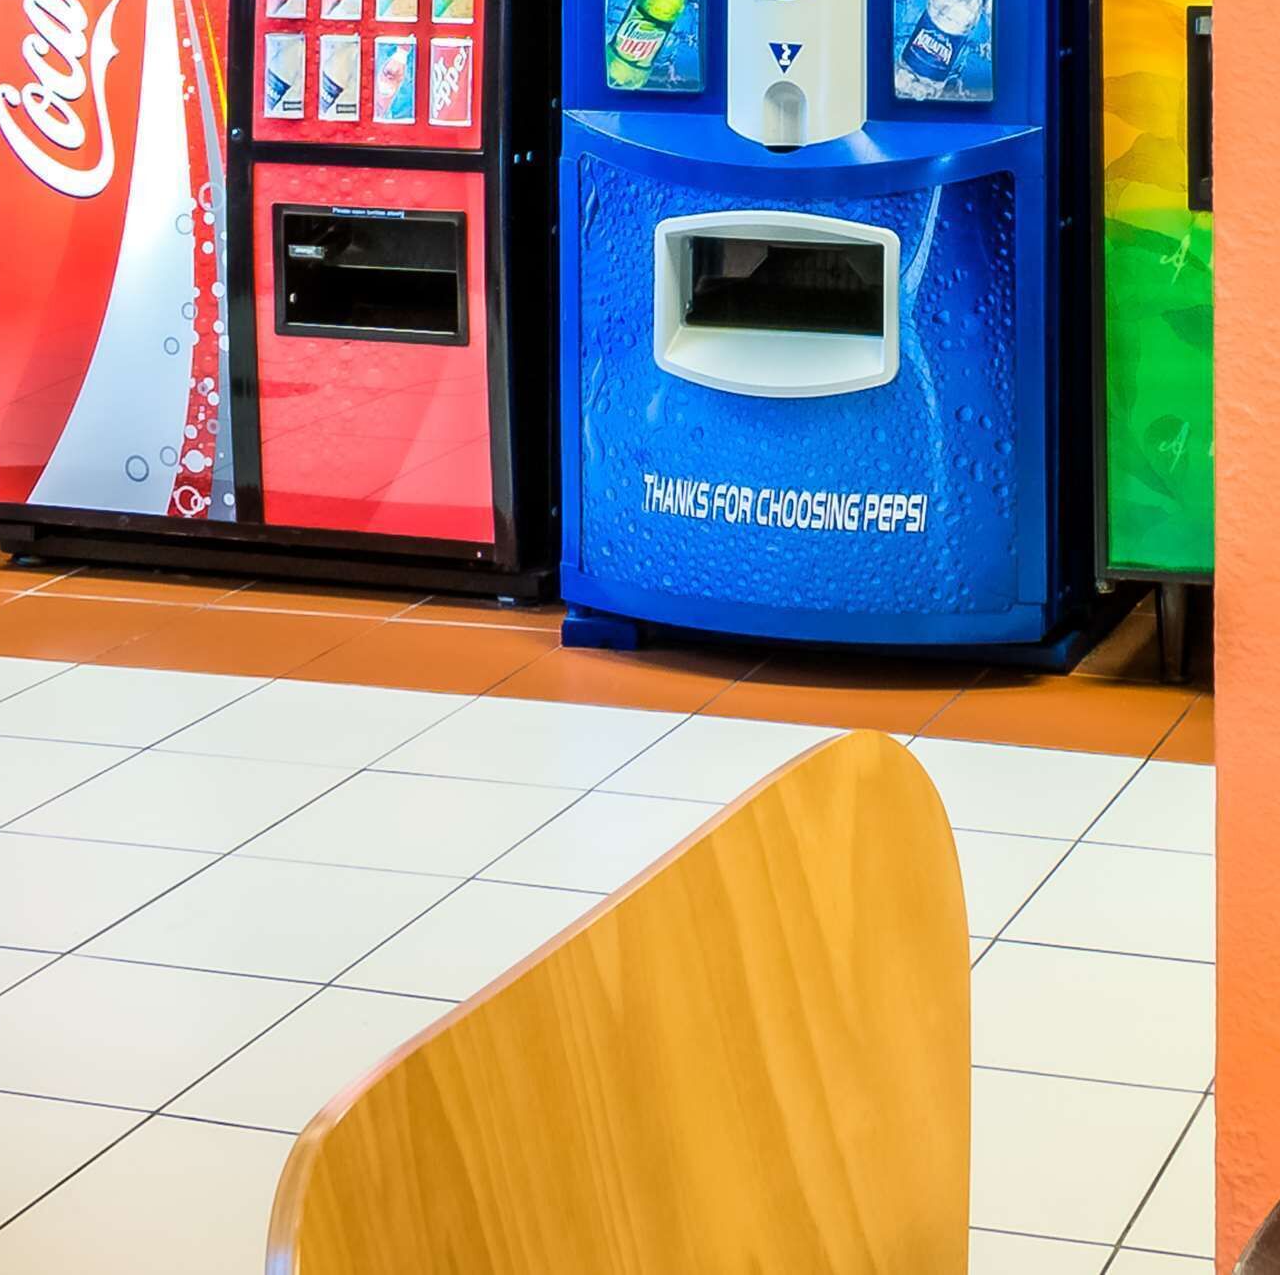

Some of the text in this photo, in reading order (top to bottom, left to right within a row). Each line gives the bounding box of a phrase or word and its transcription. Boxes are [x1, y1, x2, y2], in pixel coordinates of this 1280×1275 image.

[642, 473, 929, 533] THANKS FOR CHOOSING PEPSI
